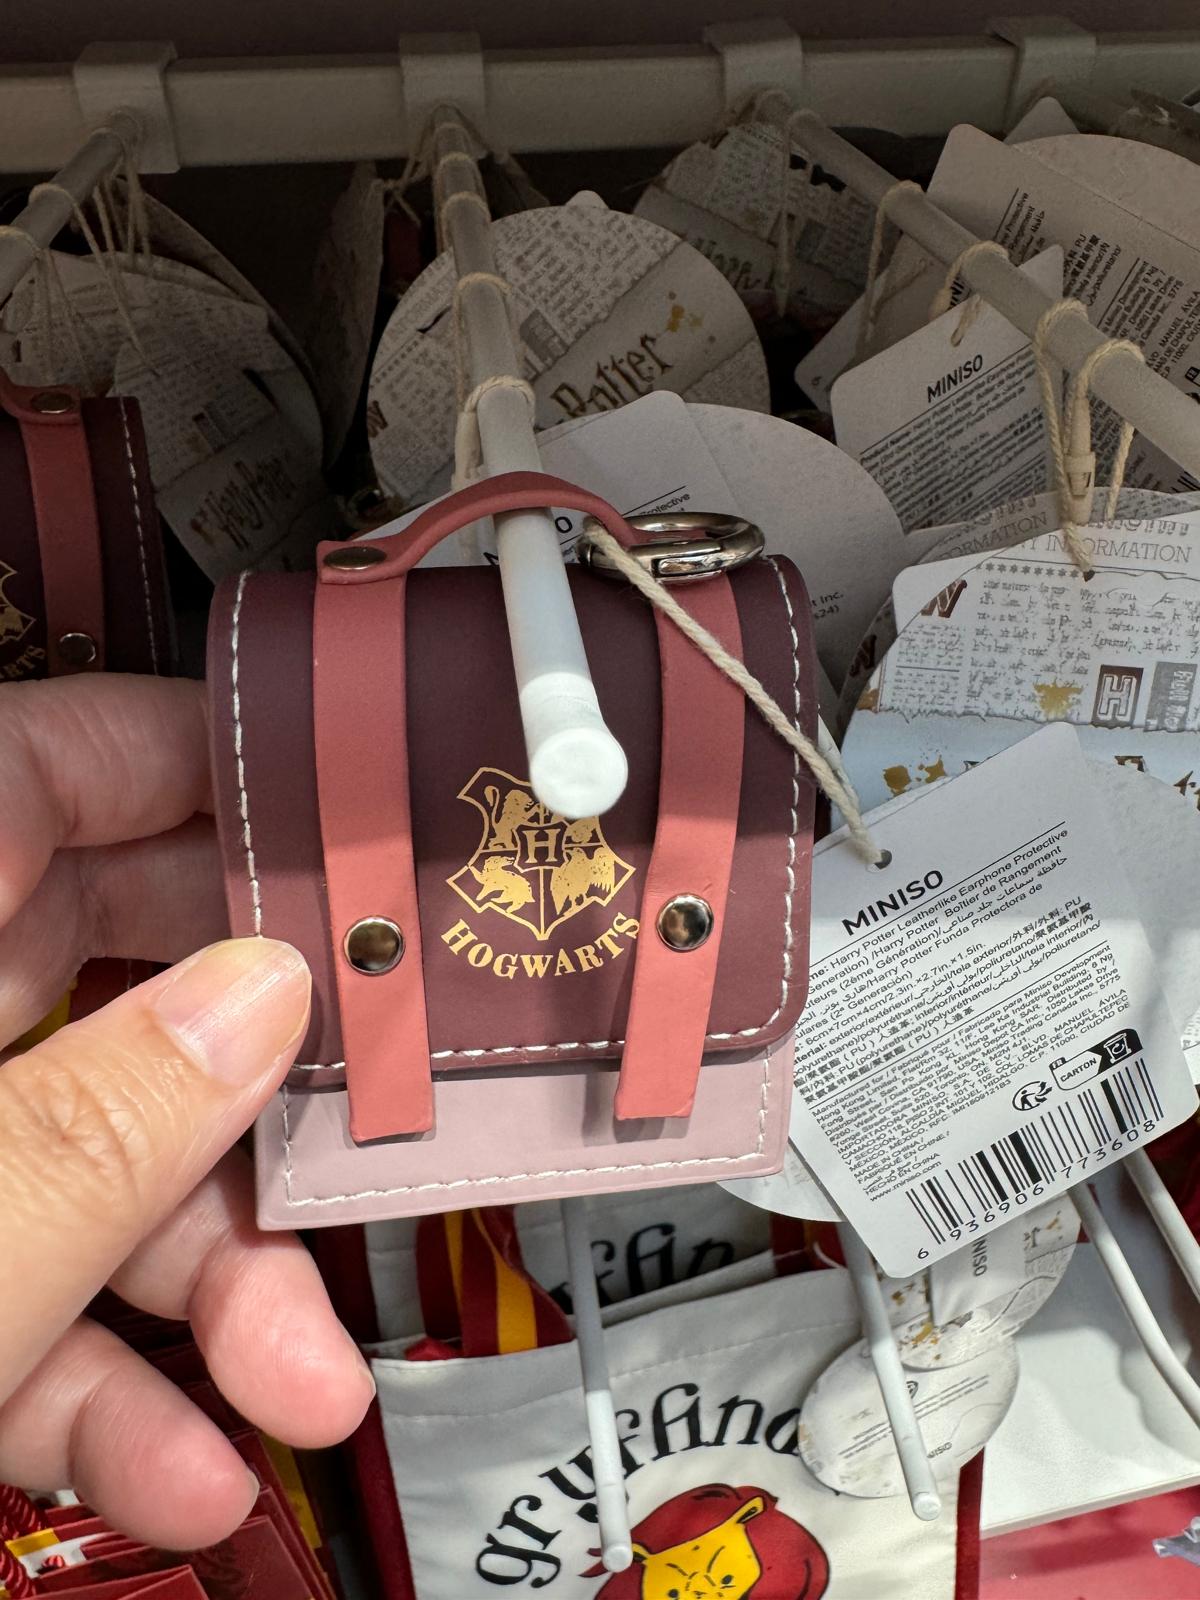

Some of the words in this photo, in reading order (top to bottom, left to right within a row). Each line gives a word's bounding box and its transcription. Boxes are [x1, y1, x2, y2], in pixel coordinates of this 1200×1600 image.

[927, 354, 984, 403] MINISO
[521, 827, 562, 866] H
[805, 965, 829, 982] me:
[830, 947, 861, 969] Harry
[861, 928, 895, 951] Potter
[897, 894, 958, 932] Leatherlike
[958, 862, 1012, 897] Earphone
[1013, 830, 1068, 866] Protective
[841, 870, 944, 936] MINISO
[900, 945, 933, 969] Potter
[934, 926, 970, 949] Funda
[971, 892, 1027, 928] Protectora
[1028, 883, 1043, 895] de
[905, 916, 939, 940] Potter
[944, 893, 980, 918] Boîtier
[982, 884, 997, 896] de
[998, 845, 1062, 887] Rangement
[440, 911, 641, 980] HOGWARTS
[793, 1042, 828, 1066] aterial:
[1064, 896, 1082, 911] PU
[847, 970, 913, 1010] Generación)
[811, 1082, 871, 1118] Manufactured
[871, 1074, 884, 1085] for
[890, 1049, 930, 1074] Fabriqué
[931, 1037, 951, 1054] pour
[957, 1009, 1002, 1037] Fabricado
[1002, 997, 1023, 1013] para
[1023, 980, 1053, 1000] Miniso
[1053, 945, 1111, 982] Development
[816, 1108, 842, 1125] Hong
[841, 1094, 866, 1111] Kong
[978, 1022, 996, 1035] Lee
[996, 1013, 1011, 1024] Ka
[1011, 988, 1051, 1015] Industrial
[1099, 953, 1115, 964] Ng
[820, 1115, 845, 1131] Fong
[879, 1085, 898, 1098] San
[901, 1076, 915, 1086] Po
[918, 1060, 943, 1076] Kong
[964, 1034, 990, 1051] Hong
[992, 1018, 1016, 1035] Kong
[1046, 973, 1093, 1004] Distributed
[1095, 965, 1107, 975] by
[824, 1110, 868, 1137] Distribués
[868, 1102, 883, 1114] par
[888, 1073, 935, 1101] Distribuido
[935, 1064, 950, 1077] por
[953, 1046, 982, 1065] Miniso
[982, 1030, 1010, 1049] Depot
[1009, 1022, 1025, 1033] CA
[1045, 996, 1068, 1015] 1050
[1068, 982, 1095, 1000] Lakes
[1095, 968, 1119, 984] Drive
[837, 1113, 908, 1155] IMPORTADORA
[975, 1065, 991, 1078] DE
[1054, 1007, 1094, 1033] MANUEL
[1099, 988, 1127, 1008] ÁVILA
[838, 1061, 855, 1075] PU
[853, 1113, 878, 1129] West
[911, 1086, 927, 1097] CA
[981, 1039, 1010, 1058] Miniso
[1010, 1019, 1044, 1040] Trading
[1044, 1000, 1078, 1022] Canada
[901, 1108, 946, 1137] ALCALDÍA
[946, 1088, 983, 1110] MIGUEL
[1080, 1010, 1116, 1034] CIUDAD
[1117, 1001, 1130, 1013] DE
[1060, 1057, 1097, 1083] CARTON
[832, 1131, 861, 1148] Yonge
[890, 1102, 914, 1117] Suite
[988, 1046, 1011, 1062] M2M
[841, 1132, 887, 1160] CAMACHO
[905, 1109, 928, 1126] PISO
[953, 1086, 969, 1098] 101
[968, 1081, 976, 1089] Y
[1017, 1040, 1050, 1063] LOMAS
[1049, 1032, 1063, 1044] DE
[1063, 994, 1129, 1036] CHAPULTEPEC
[853, 1161, 881, 1179] MADE
[880, 1155, 892, 1164] IN
[891, 1140, 921, 1158] CHINA
[857, 1156, 903, 1185] FABRIQUÉ
[902, 1149, 917, 1160] EN
[917, 1133, 946, 1152] CHINE
[865, 1175, 898, 1196] HECHO
[897, 1167, 912, 1178] EN
[911, 1152, 941, 1170] CHINA
[869, 1161, 942, 1202] www.miniso.com
[917, 1247, 930, 1260] 6
[949, 1183, 1045, 1241] 936906
[1061, 1119, 1156, 1179] 773608
[968, 1237, 986, 1277] NISO
